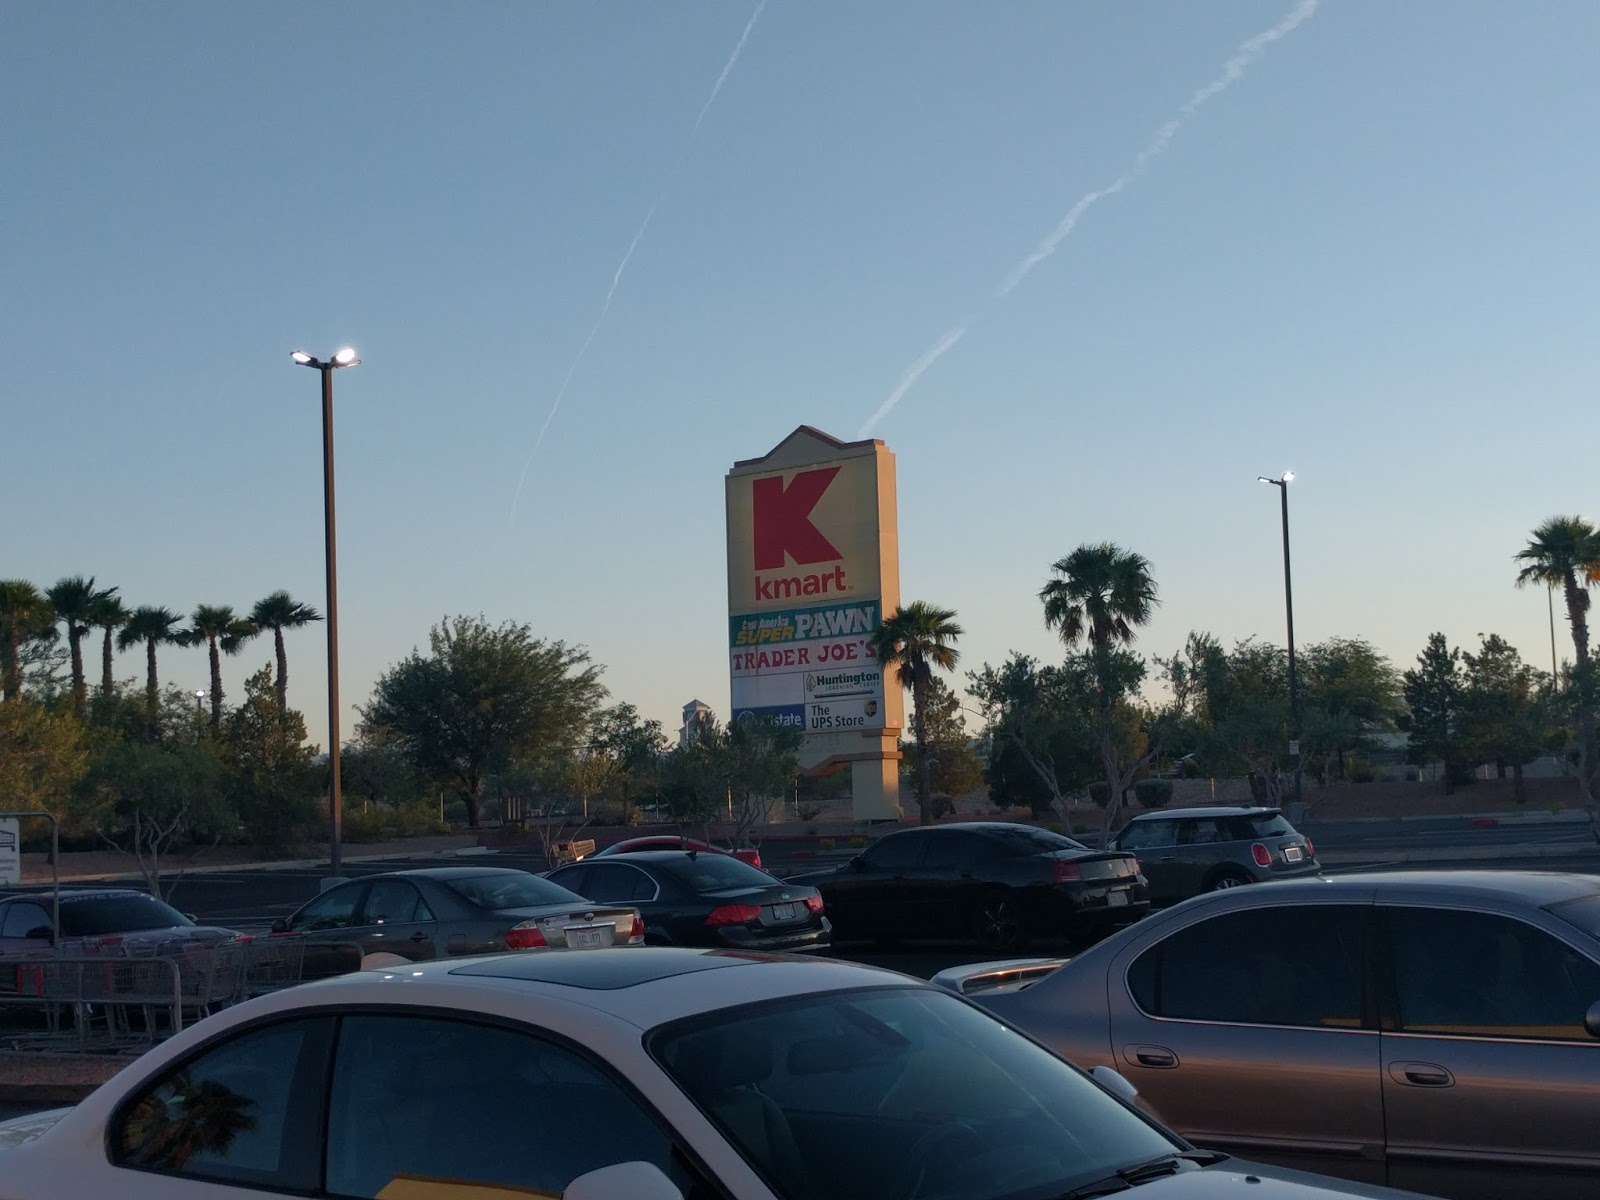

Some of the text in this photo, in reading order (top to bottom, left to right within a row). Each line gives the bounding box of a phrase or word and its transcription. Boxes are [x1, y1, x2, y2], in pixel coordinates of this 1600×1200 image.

[753, 466, 844, 571] K
[754, 565, 846, 601] kmart
[736, 606, 875, 645] SUPER PAWN
[733, 640, 877, 671] TRADER JOE'S
[816, 672, 880, 686] Huntington
[811, 705, 830, 716] The
[811, 715, 864, 729] UPS Store
